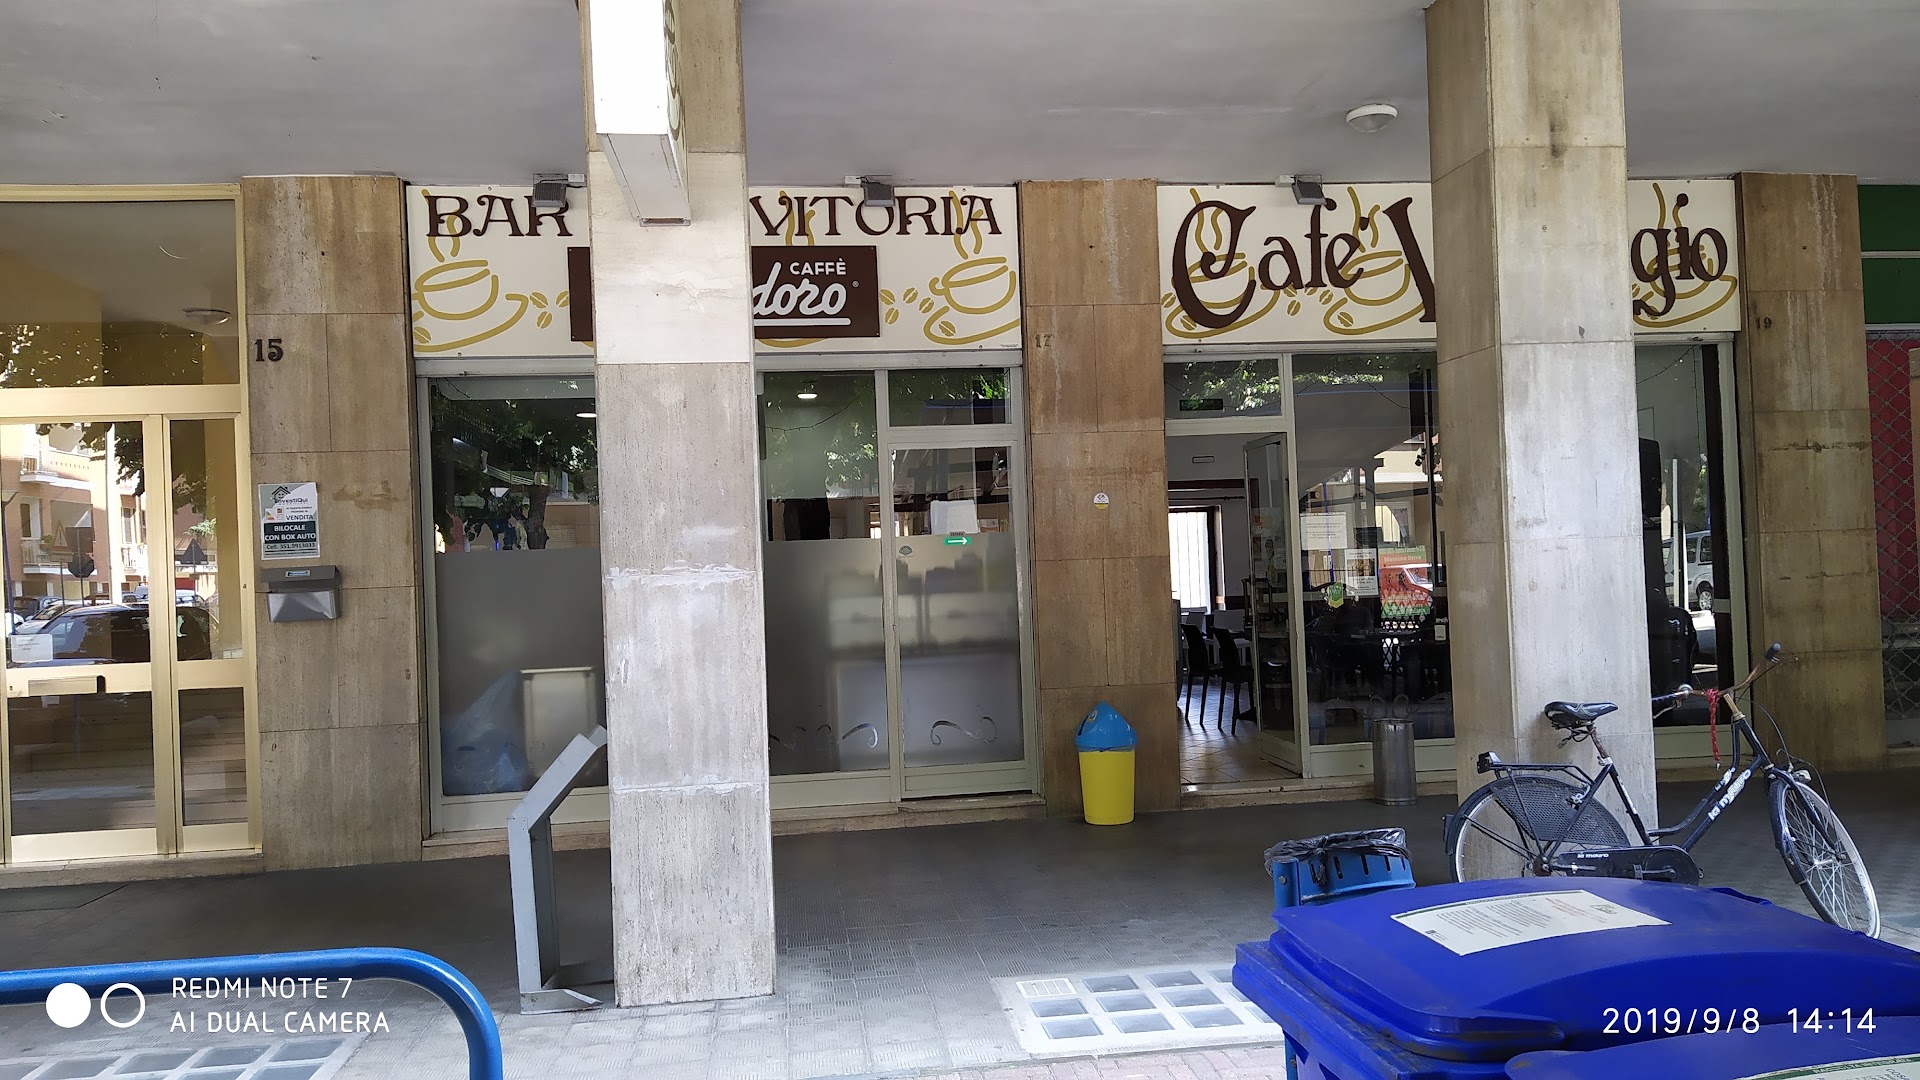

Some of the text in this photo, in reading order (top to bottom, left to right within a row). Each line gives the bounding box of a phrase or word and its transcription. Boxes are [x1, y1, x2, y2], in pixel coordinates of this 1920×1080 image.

[426, 195, 1002, 237] BAR VITORIA
[1631, 193, 1728, 317] gio
[789, 257, 847, 276] CAFFÈ
[752, 261, 847, 316] doro
[1755, 316, 1772, 329] 19
[254, 338, 284, 362] 15
[273, 524, 306, 532] BILOCALE
[281, 533, 296, 541] BOX
[296, 532, 316, 540] AUTO
